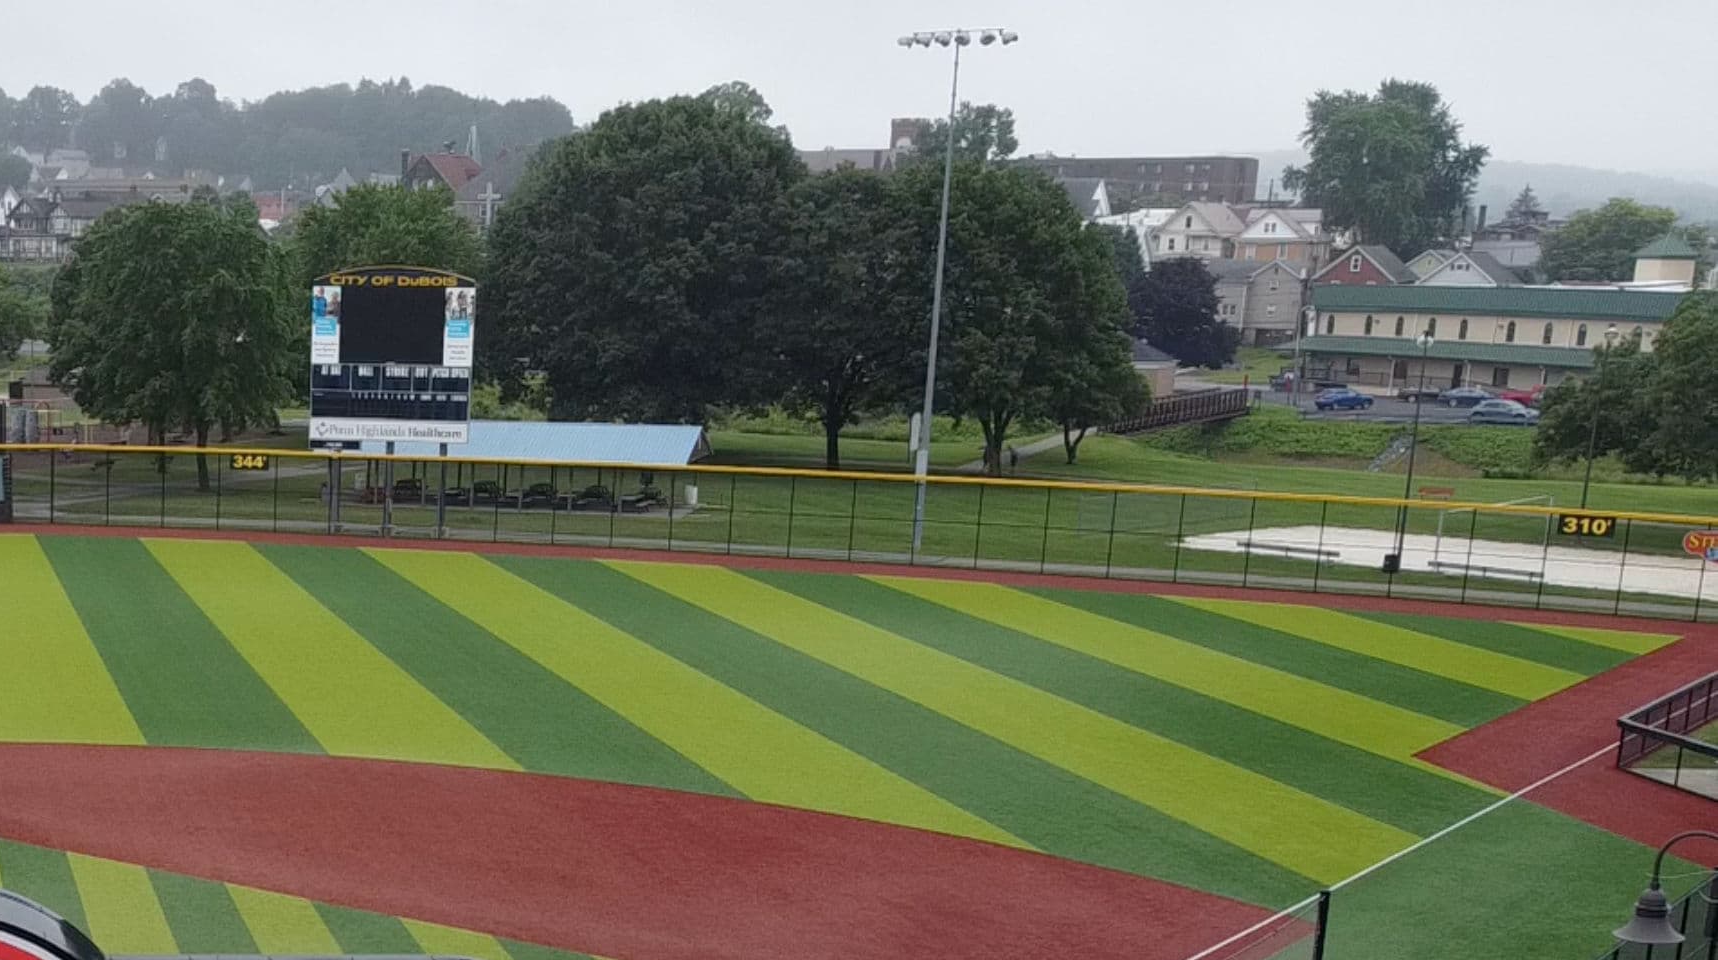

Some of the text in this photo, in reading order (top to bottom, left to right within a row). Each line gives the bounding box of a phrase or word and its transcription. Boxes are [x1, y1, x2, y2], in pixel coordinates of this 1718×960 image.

[329, 273, 369, 286] CITY
[371, 275, 395, 286] OF
[408, 426, 462, 439] Healthcare
